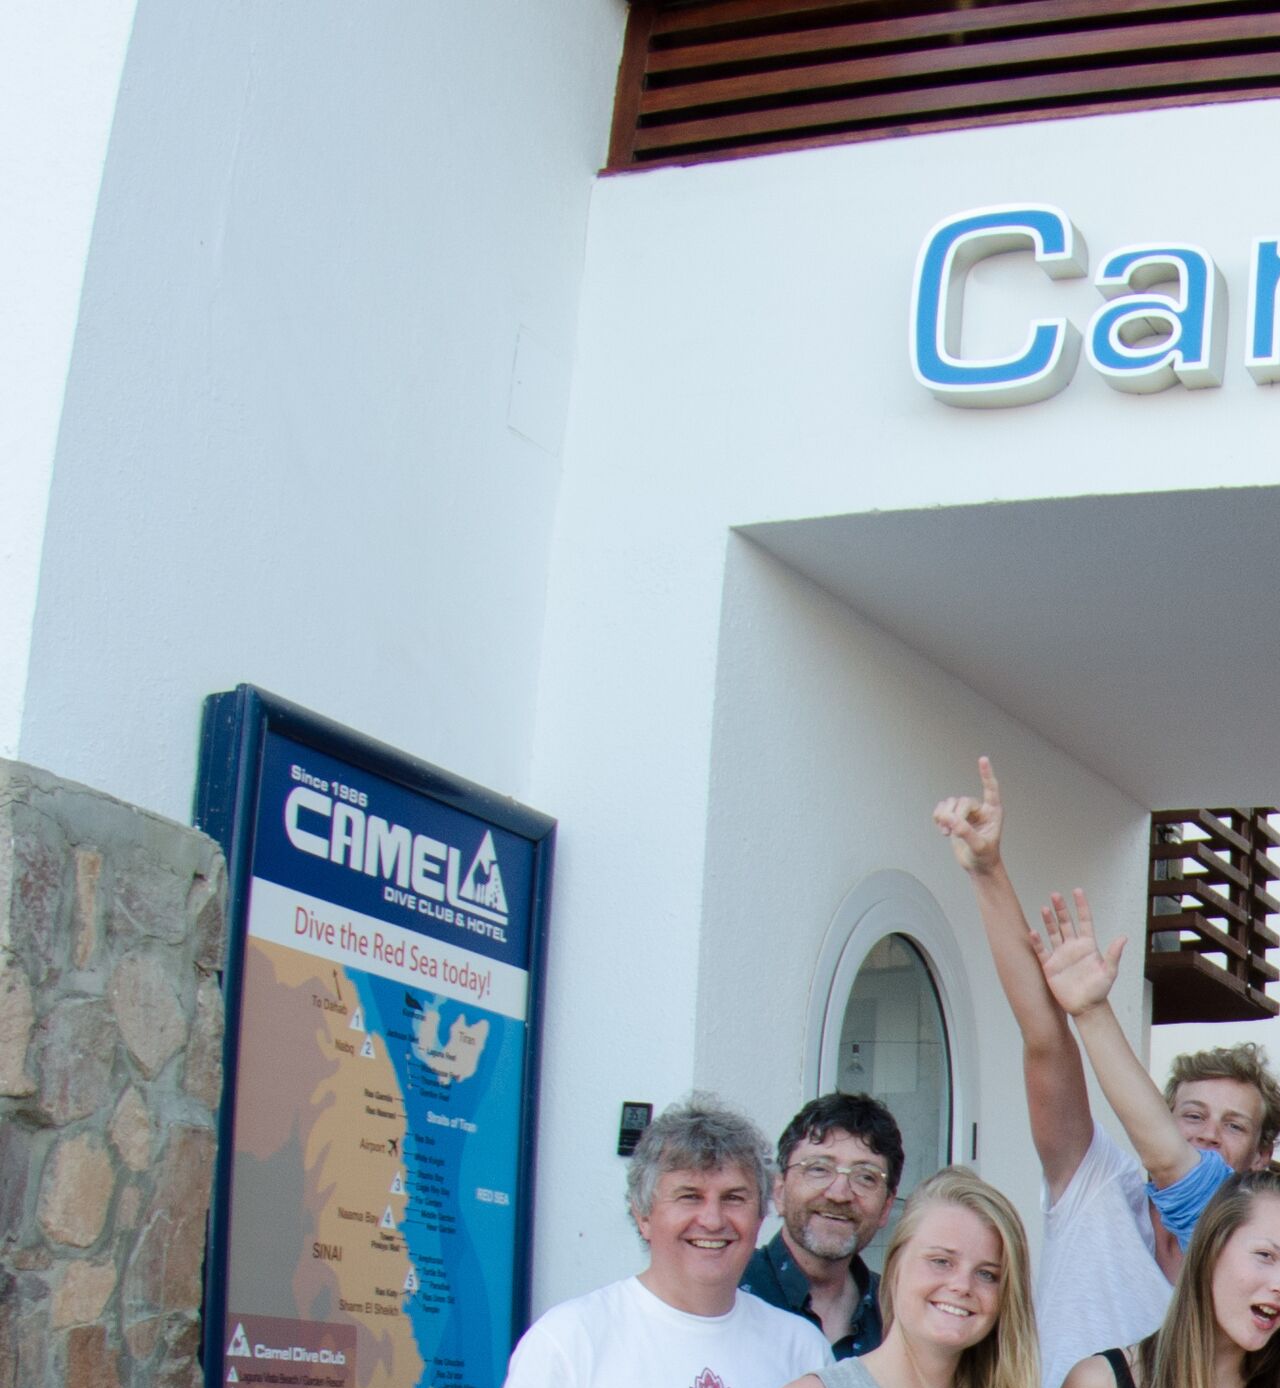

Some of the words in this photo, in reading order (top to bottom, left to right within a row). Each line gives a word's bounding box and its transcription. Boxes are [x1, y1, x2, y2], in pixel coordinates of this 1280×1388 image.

[290, 764, 329, 792] Since
[331, 780, 368, 808] 1986
[285, 786, 508, 926] CAMEL
[384, 886, 417, 911] DIVE
[417, 899, 454, 924] CLUB
[454, 912, 465, 928] &
[467, 917, 508, 943] HOTEL
[294, 906, 336, 945] Dive
[340, 922, 368, 956] the
[373, 933, 406, 968] Red
[410, 945, 438, 978] Sea
[443, 960, 492, 998] today!
[312, 1242, 342, 1262] SINAI
[254, 1343, 292, 1360] Camel
[292, 1347, 319, 1363] Dive
[319, 1349, 346, 1365] Club
